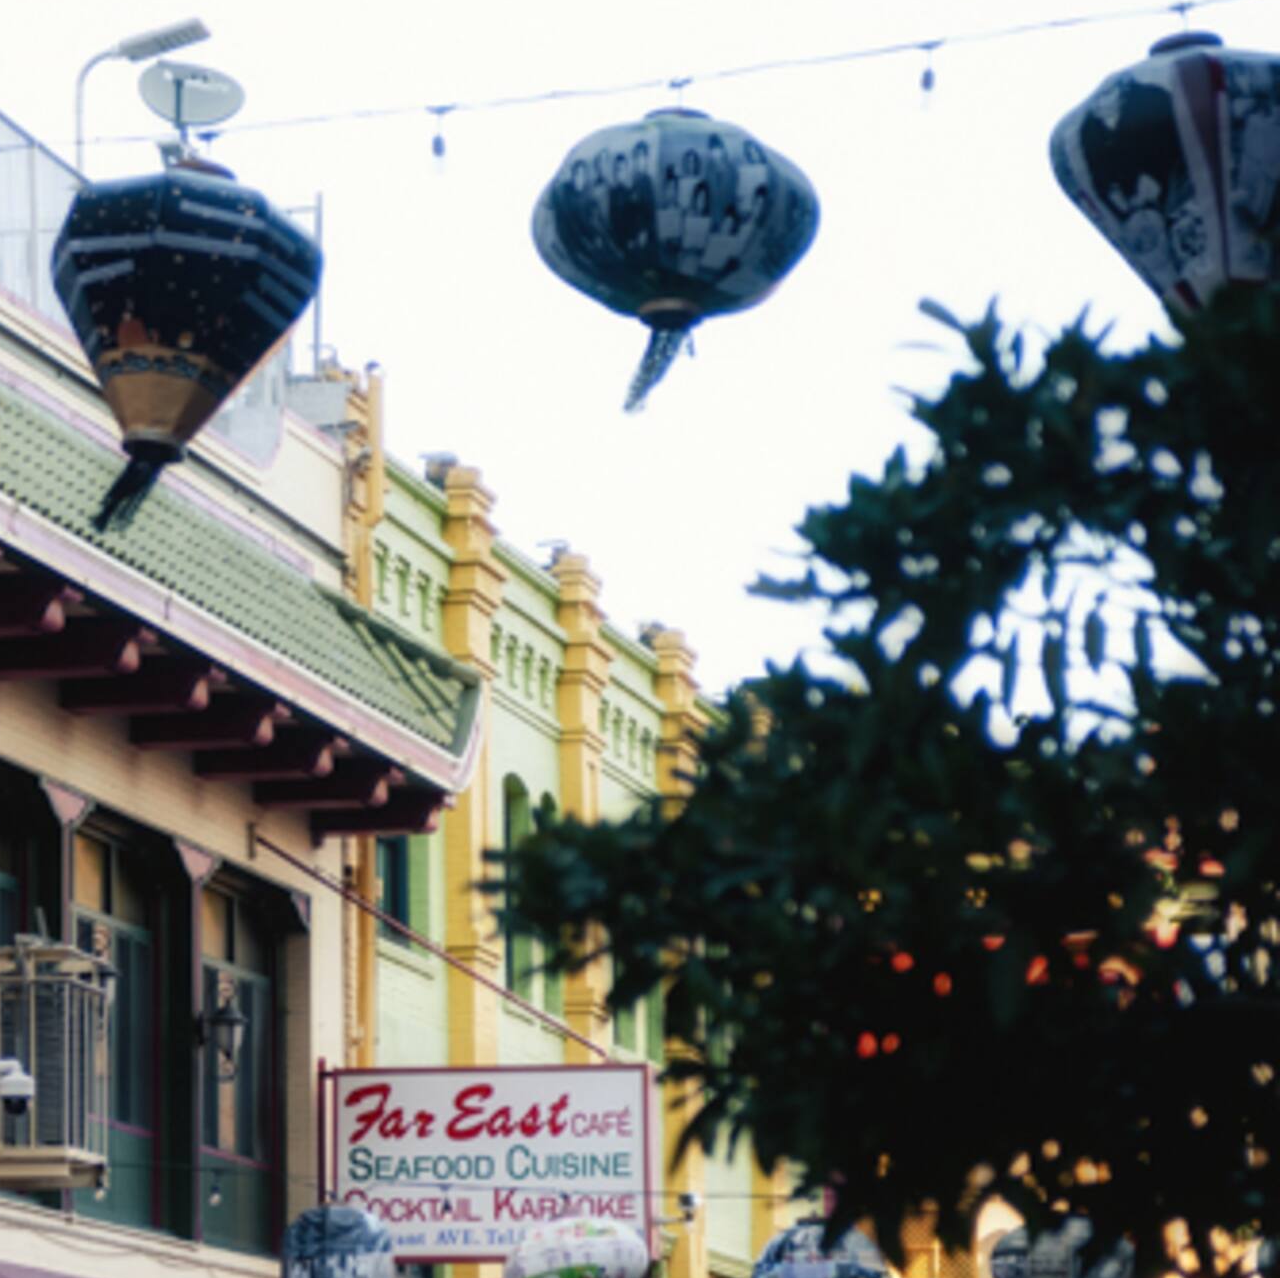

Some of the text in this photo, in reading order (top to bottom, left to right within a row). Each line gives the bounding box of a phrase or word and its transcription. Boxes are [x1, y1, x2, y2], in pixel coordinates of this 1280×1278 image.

[344, 1083, 435, 1144] Far
[445, 1083, 569, 1141] East
[348, 1144, 633, 1182] SEAFOOD CUISINE
